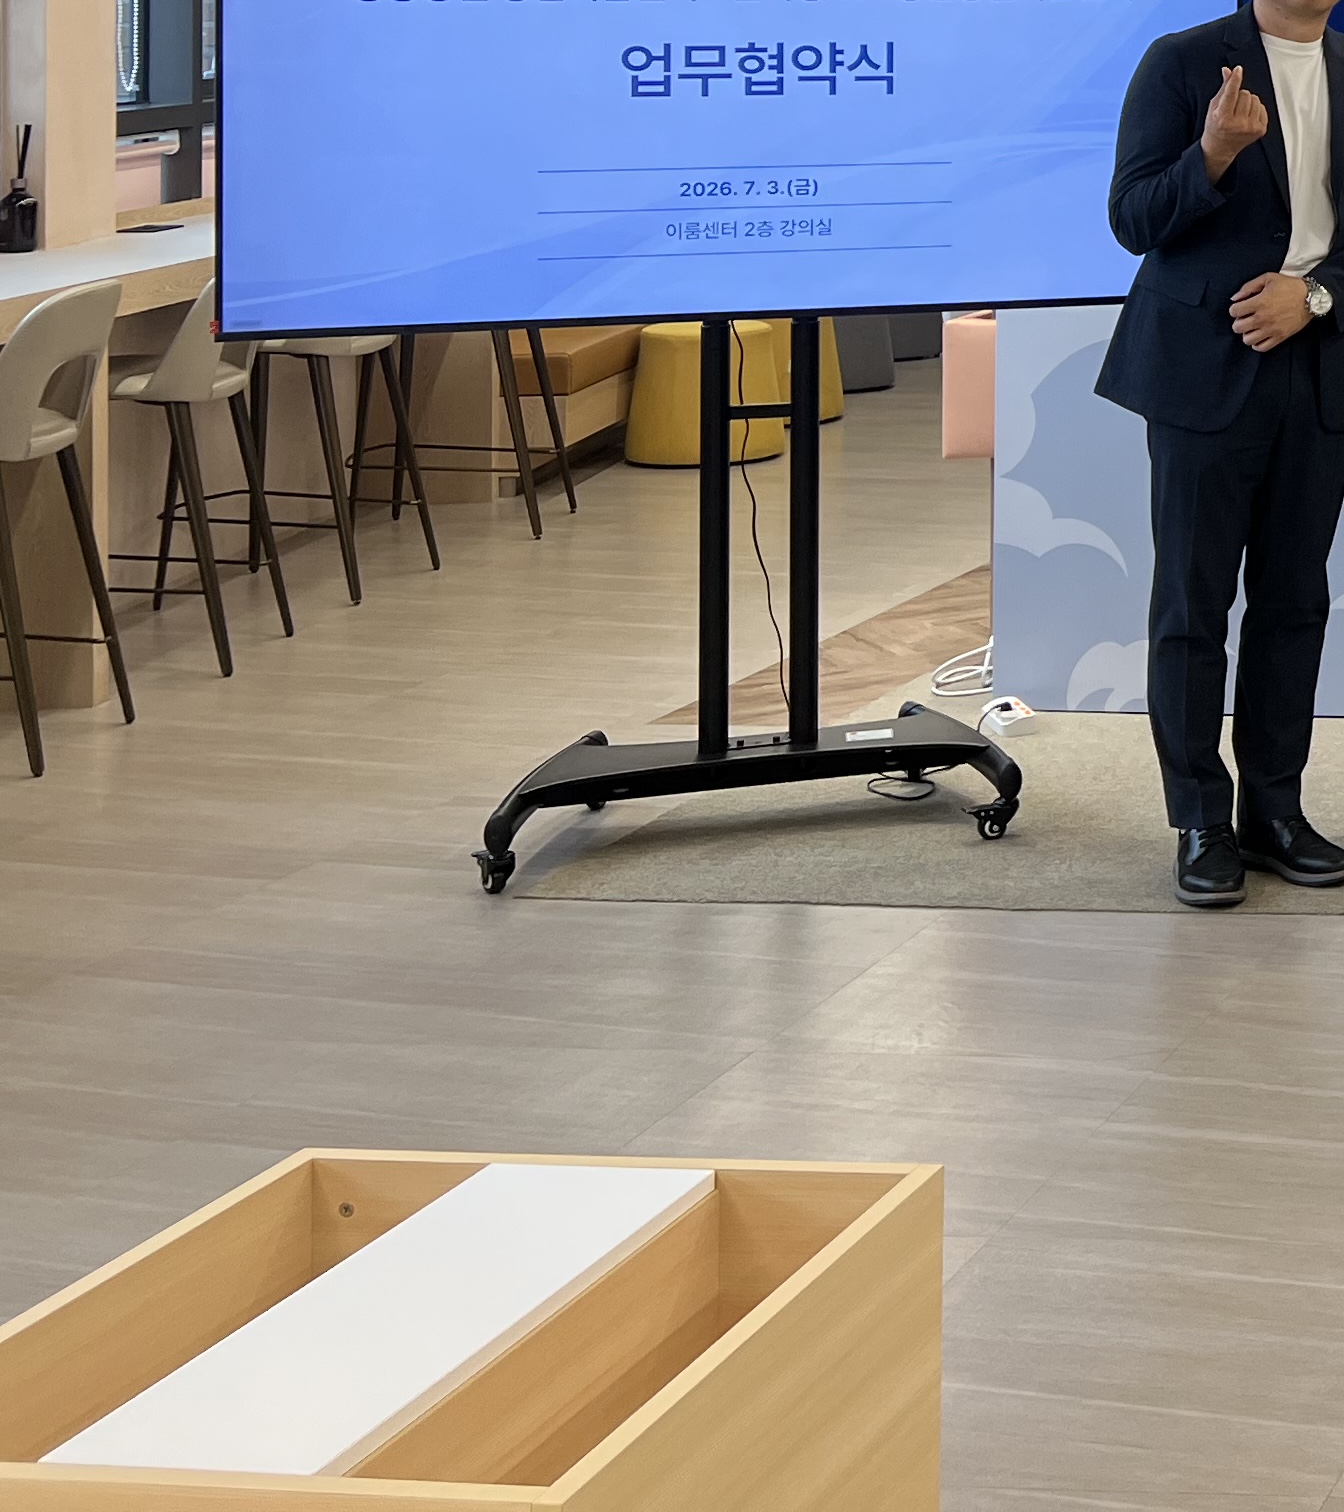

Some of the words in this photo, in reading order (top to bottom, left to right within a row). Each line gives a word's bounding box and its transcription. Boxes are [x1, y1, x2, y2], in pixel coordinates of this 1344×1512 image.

[621, 41, 895, 98] 업무협약식
[679, 181, 738, 198] 2026.
[665, 220, 738, 240] 이룸센터
[744, 220, 774, 238] 2층
[779, 217, 833, 238] 강의실
